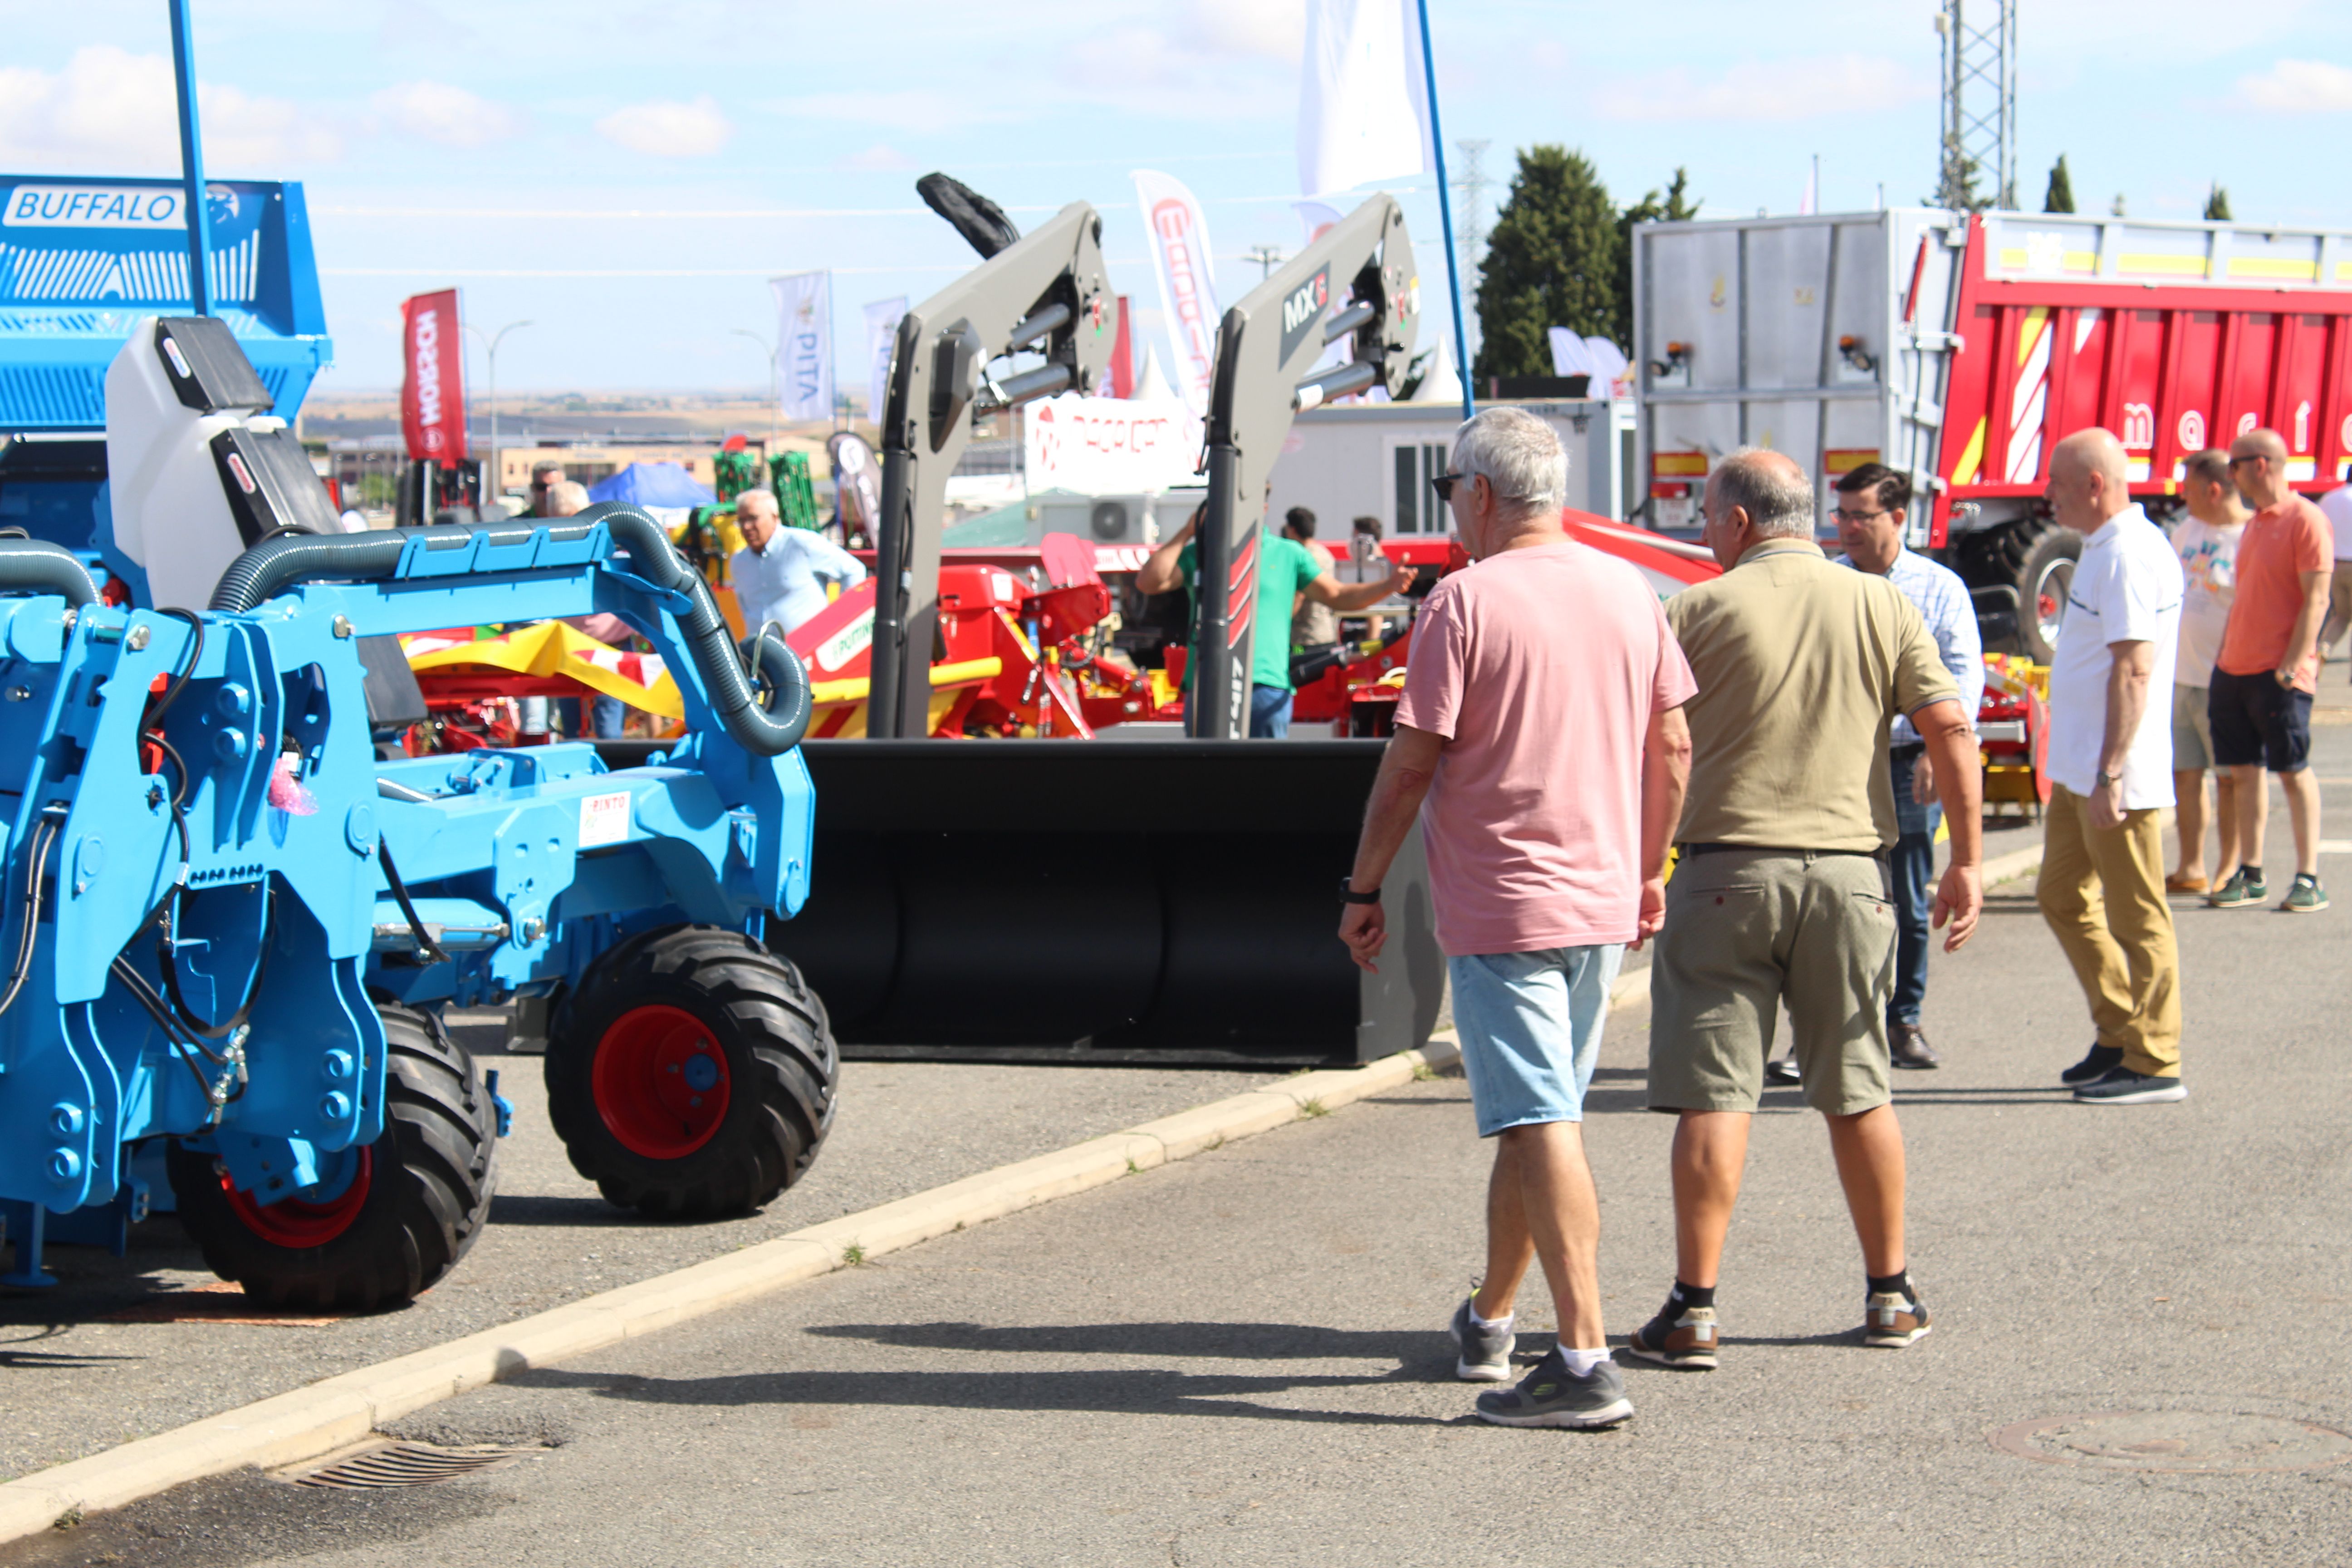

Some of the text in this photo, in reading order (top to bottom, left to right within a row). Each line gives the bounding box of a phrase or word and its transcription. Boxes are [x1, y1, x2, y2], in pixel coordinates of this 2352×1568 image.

[15, 191, 176, 221] BUFFALO
[1283, 279, 1318, 334] MX
[795, 332, 819, 403] PITA
[592, 795, 625, 813] PINTO
